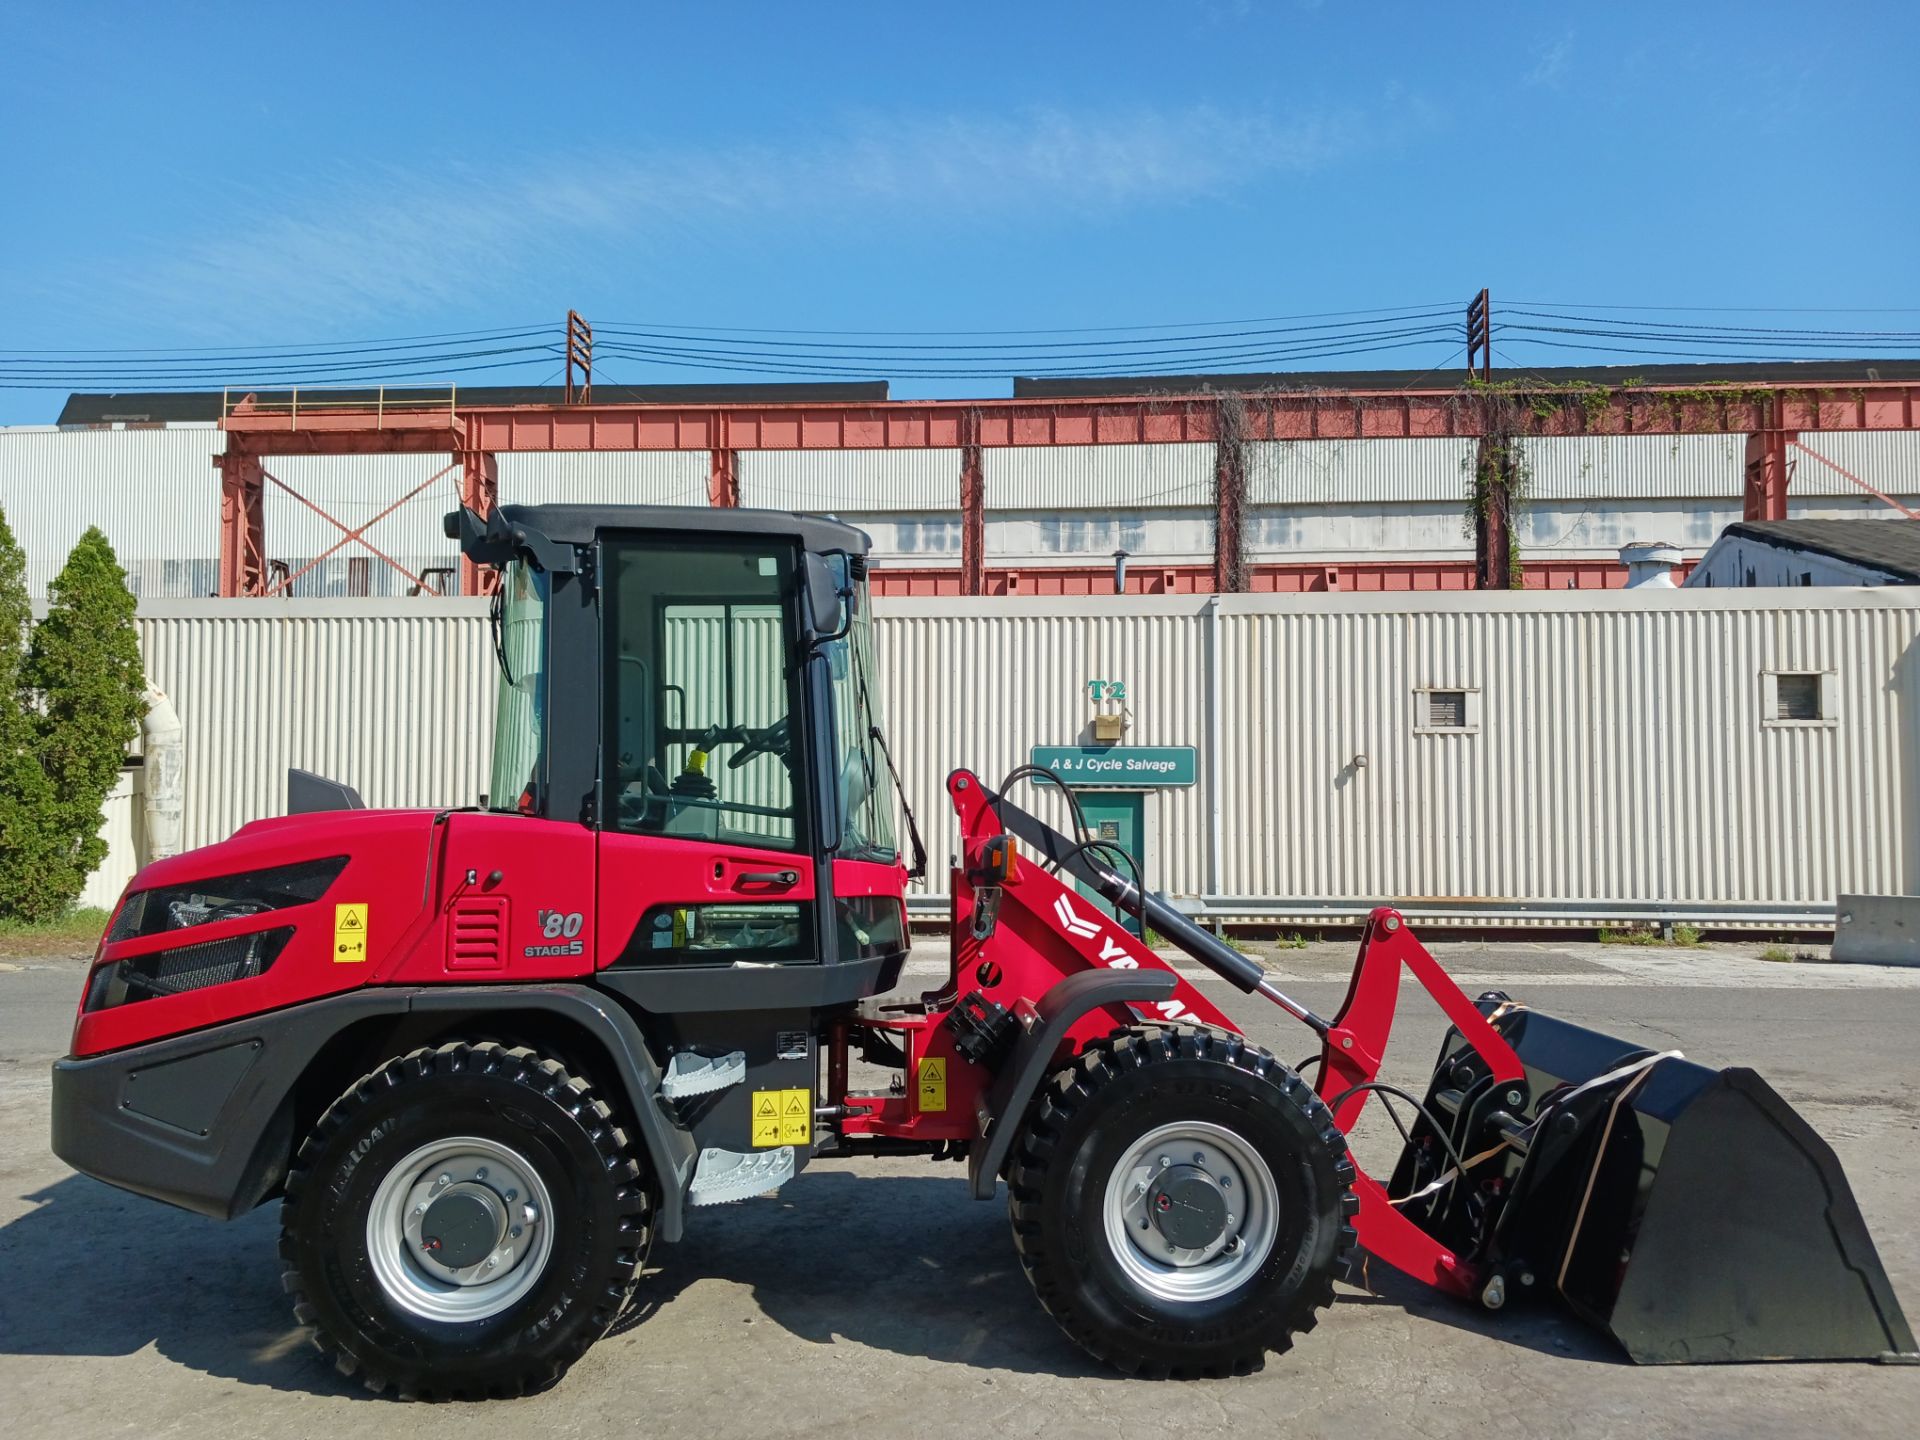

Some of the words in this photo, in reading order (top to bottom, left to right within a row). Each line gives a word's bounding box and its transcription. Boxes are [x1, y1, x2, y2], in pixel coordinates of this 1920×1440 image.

[1050, 758, 1060, 770] A
[1063, 758, 1073, 770] &
[1076, 758, 1084, 770] J
[1086, 758, 1123, 773] Cycle
[1126, 758, 1177, 774] Salvage
